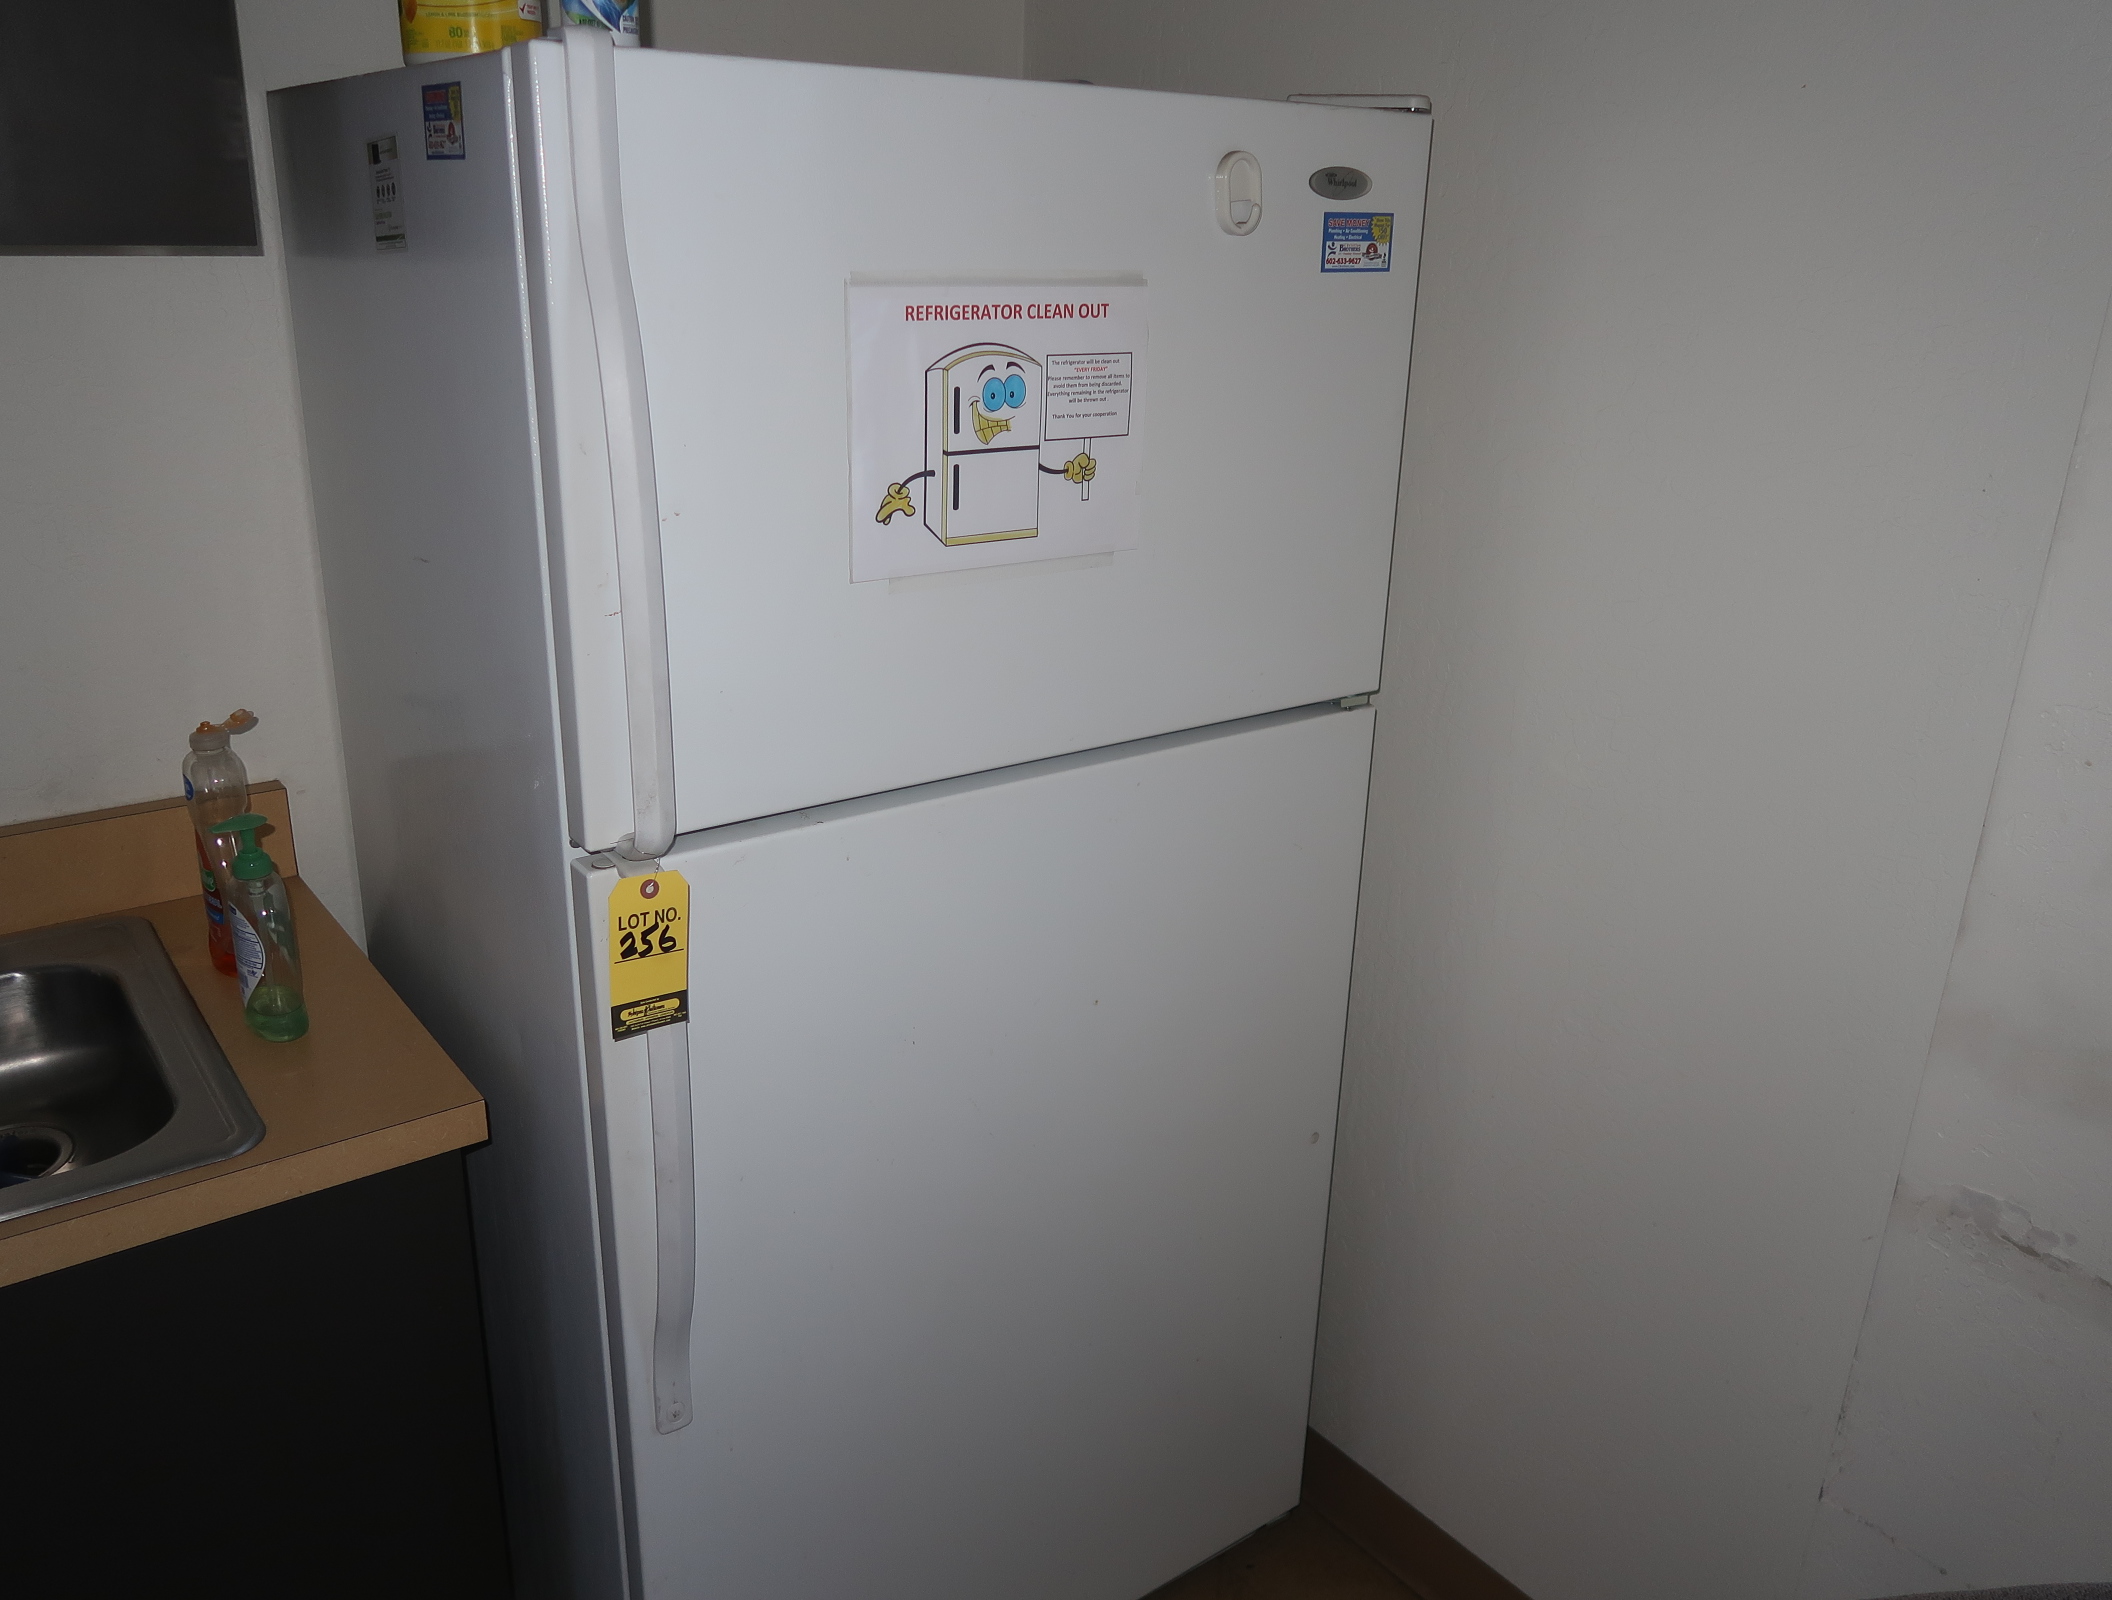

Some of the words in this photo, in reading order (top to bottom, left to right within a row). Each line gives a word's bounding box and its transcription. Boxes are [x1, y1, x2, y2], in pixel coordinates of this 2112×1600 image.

[449, 26, 463, 38] 80
[1327, 177, 1357, 189] Whirlpool
[1328, 218, 1346, 227] SAVE
[1346, 218, 1370, 228] MONEY
[904, 304, 1024, 321] REFRIGERATOR
[1027, 303, 1074, 319] CLEAN
[1078, 303, 1110, 319] OUT
[618, 911, 650, 931] LOT
[654, 906, 681, 926] NO.
[619, 921, 677, 960] 256
